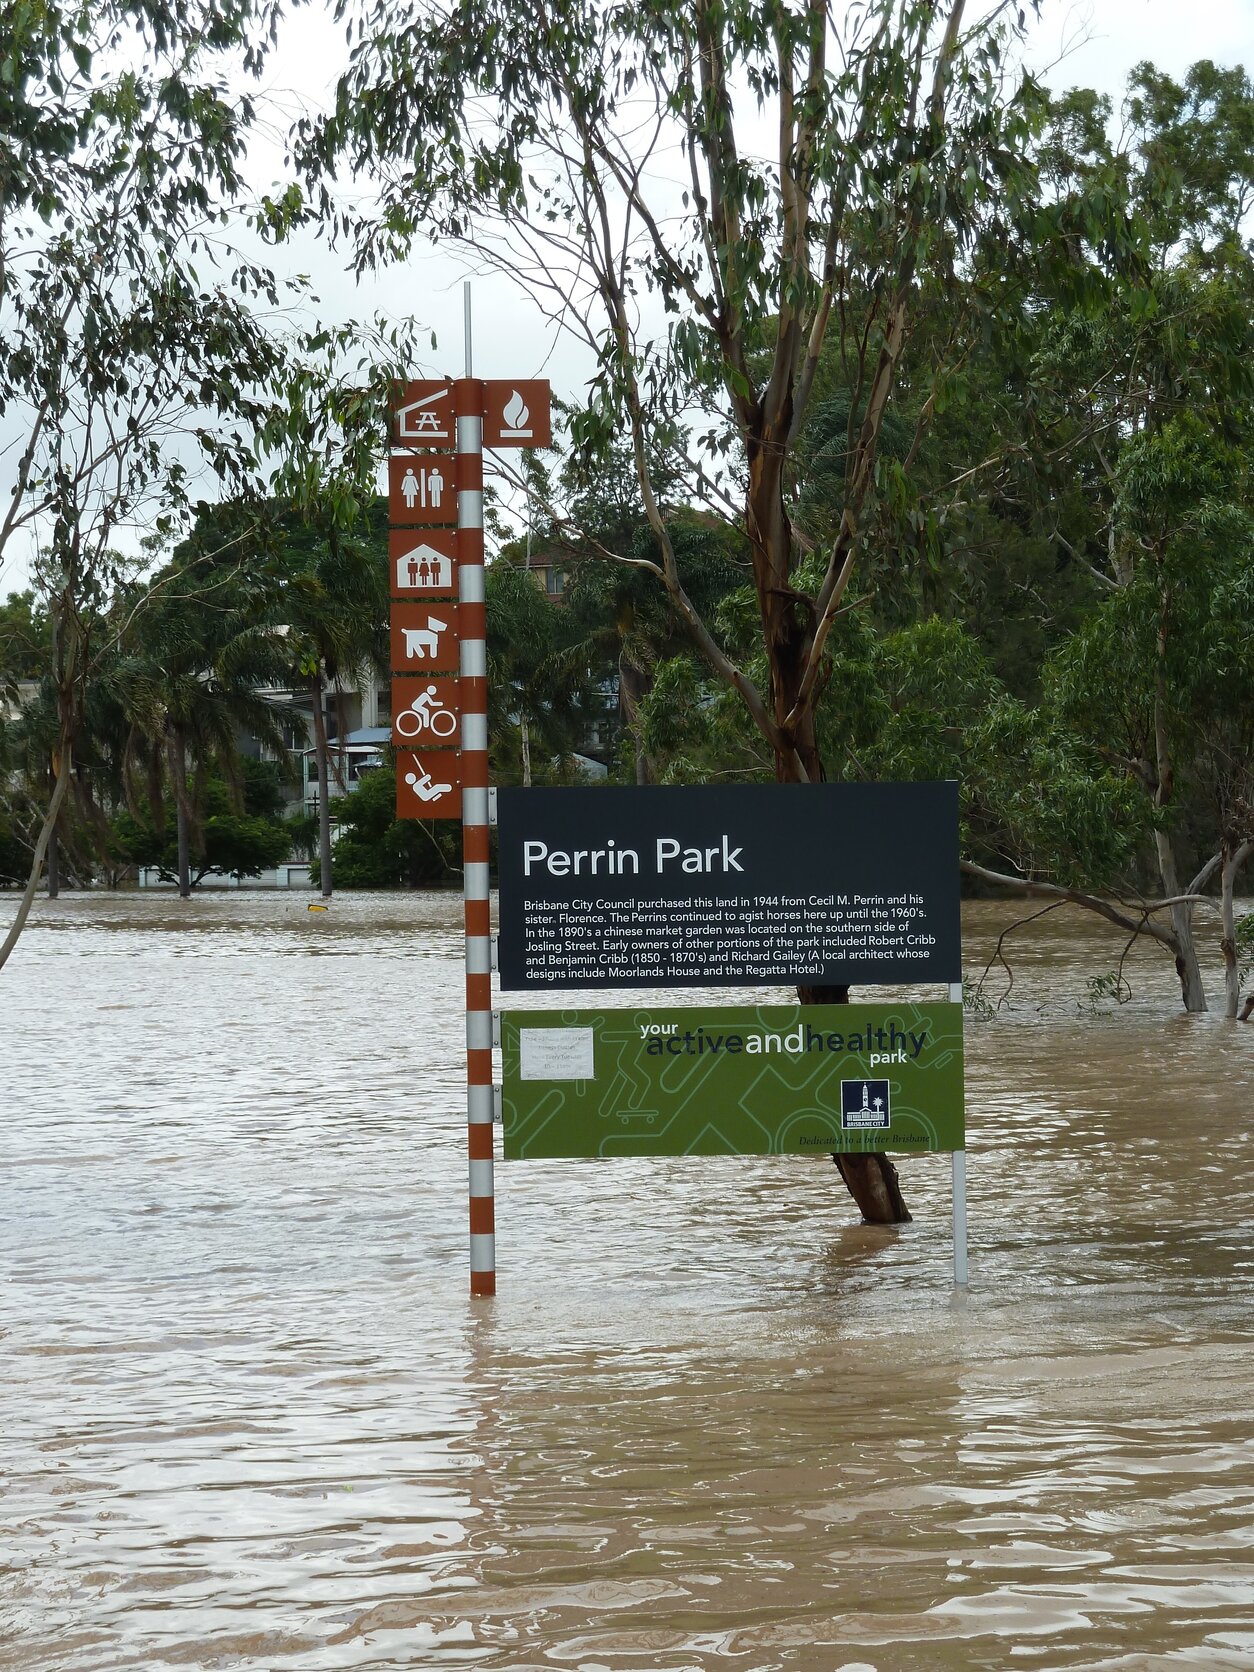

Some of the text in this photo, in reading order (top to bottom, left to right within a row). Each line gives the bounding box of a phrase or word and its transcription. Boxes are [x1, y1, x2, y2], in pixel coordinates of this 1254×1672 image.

[523, 834, 745, 876] Perrin Park
[524, 893, 924, 912] Brisbane City Council purchased this land in 1944 from Cecil M. Perrin and his
[559, 913, 607, 923] Florence.
[609, 912, 630, 922] The
[631, 912, 667, 922] Perrins
[670, 910, 722, 922] continued
[724, 912, 736, 921] to
[739, 910, 764, 923] agist
[767, 909, 801, 920] horses
[804, 909, 827, 919] here
[830, 911, 843, 922] up
[846, 908, 868, 919] until
[871, 908, 889, 918] the
[891, 907, 927, 918] 1960's.
[526, 920, 909, 938] In the 1890's a chinese market garden was located on the southern side of
[525, 934, 936, 954] Josling Street. Early owners of other portions of the park included Robert Cribb
[526, 954, 545, 965] and
[549, 954, 596, 967] Benjamin
[599, 953, 628, 964] Cribb
[631, 952, 660, 965] (1850
[670, 952, 707, 963] 1870's)
[709, 951, 728, 962] and
[731, 950, 770, 961] Richard
[773, 950, 805, 963] Gailey
[808, 950, 820, 962] (A
[822, 949, 846, 960] local
[849, 948, 894, 960] architect
[896, 947, 930, 958] whose
[526, 963, 824, 981] designs include Moorlands House and the Regatta Hotel.)
[640, 1023, 678, 1038] your
[870, 1048, 907, 1067] park
[799, 1135, 842, 1145] Dedicated
[845, 1136, 854, 1144] to
[865, 1135, 889, 1144] better
[892, 1133, 930, 1143] Brisbane
